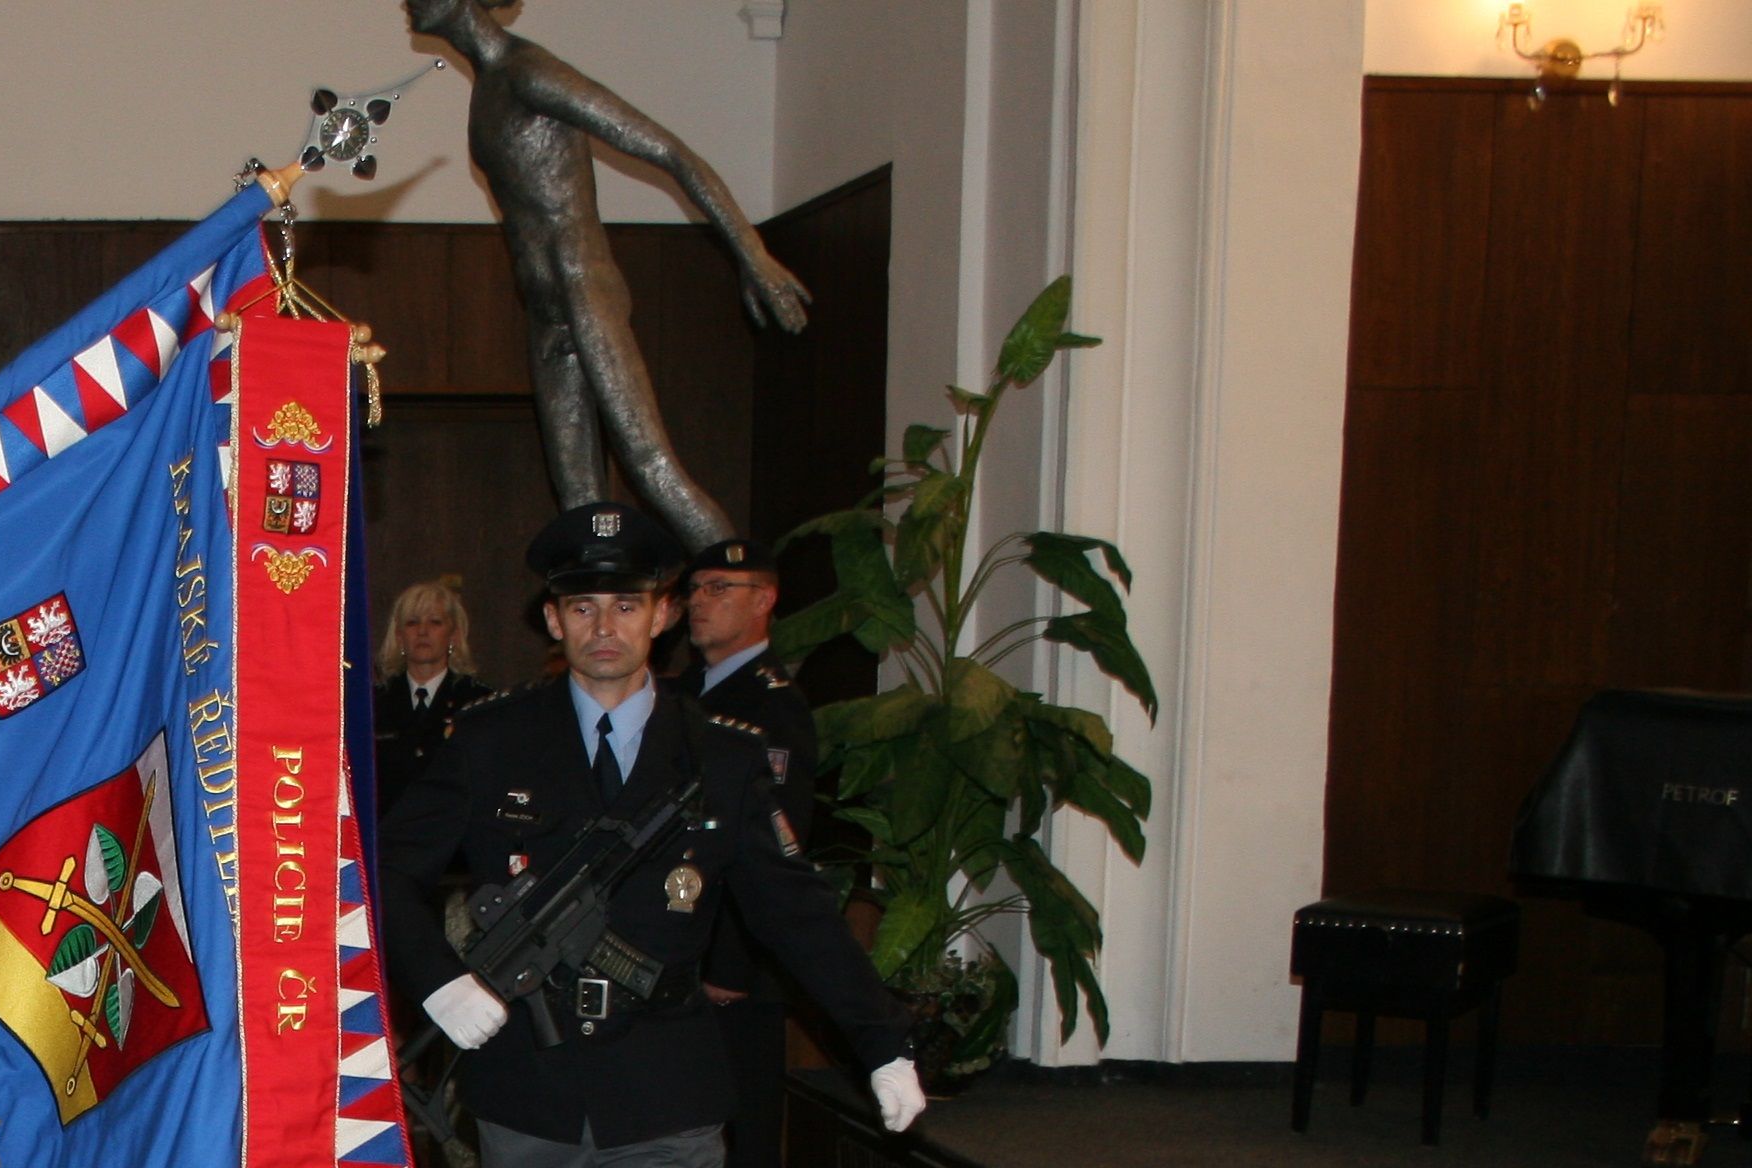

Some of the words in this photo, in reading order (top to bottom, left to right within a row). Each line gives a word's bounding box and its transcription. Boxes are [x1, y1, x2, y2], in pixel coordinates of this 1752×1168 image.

[1661, 783, 1740, 806] PETROF
[271, 744, 307, 944] POLICIE
[276, 967, 317, 1036] ČR
